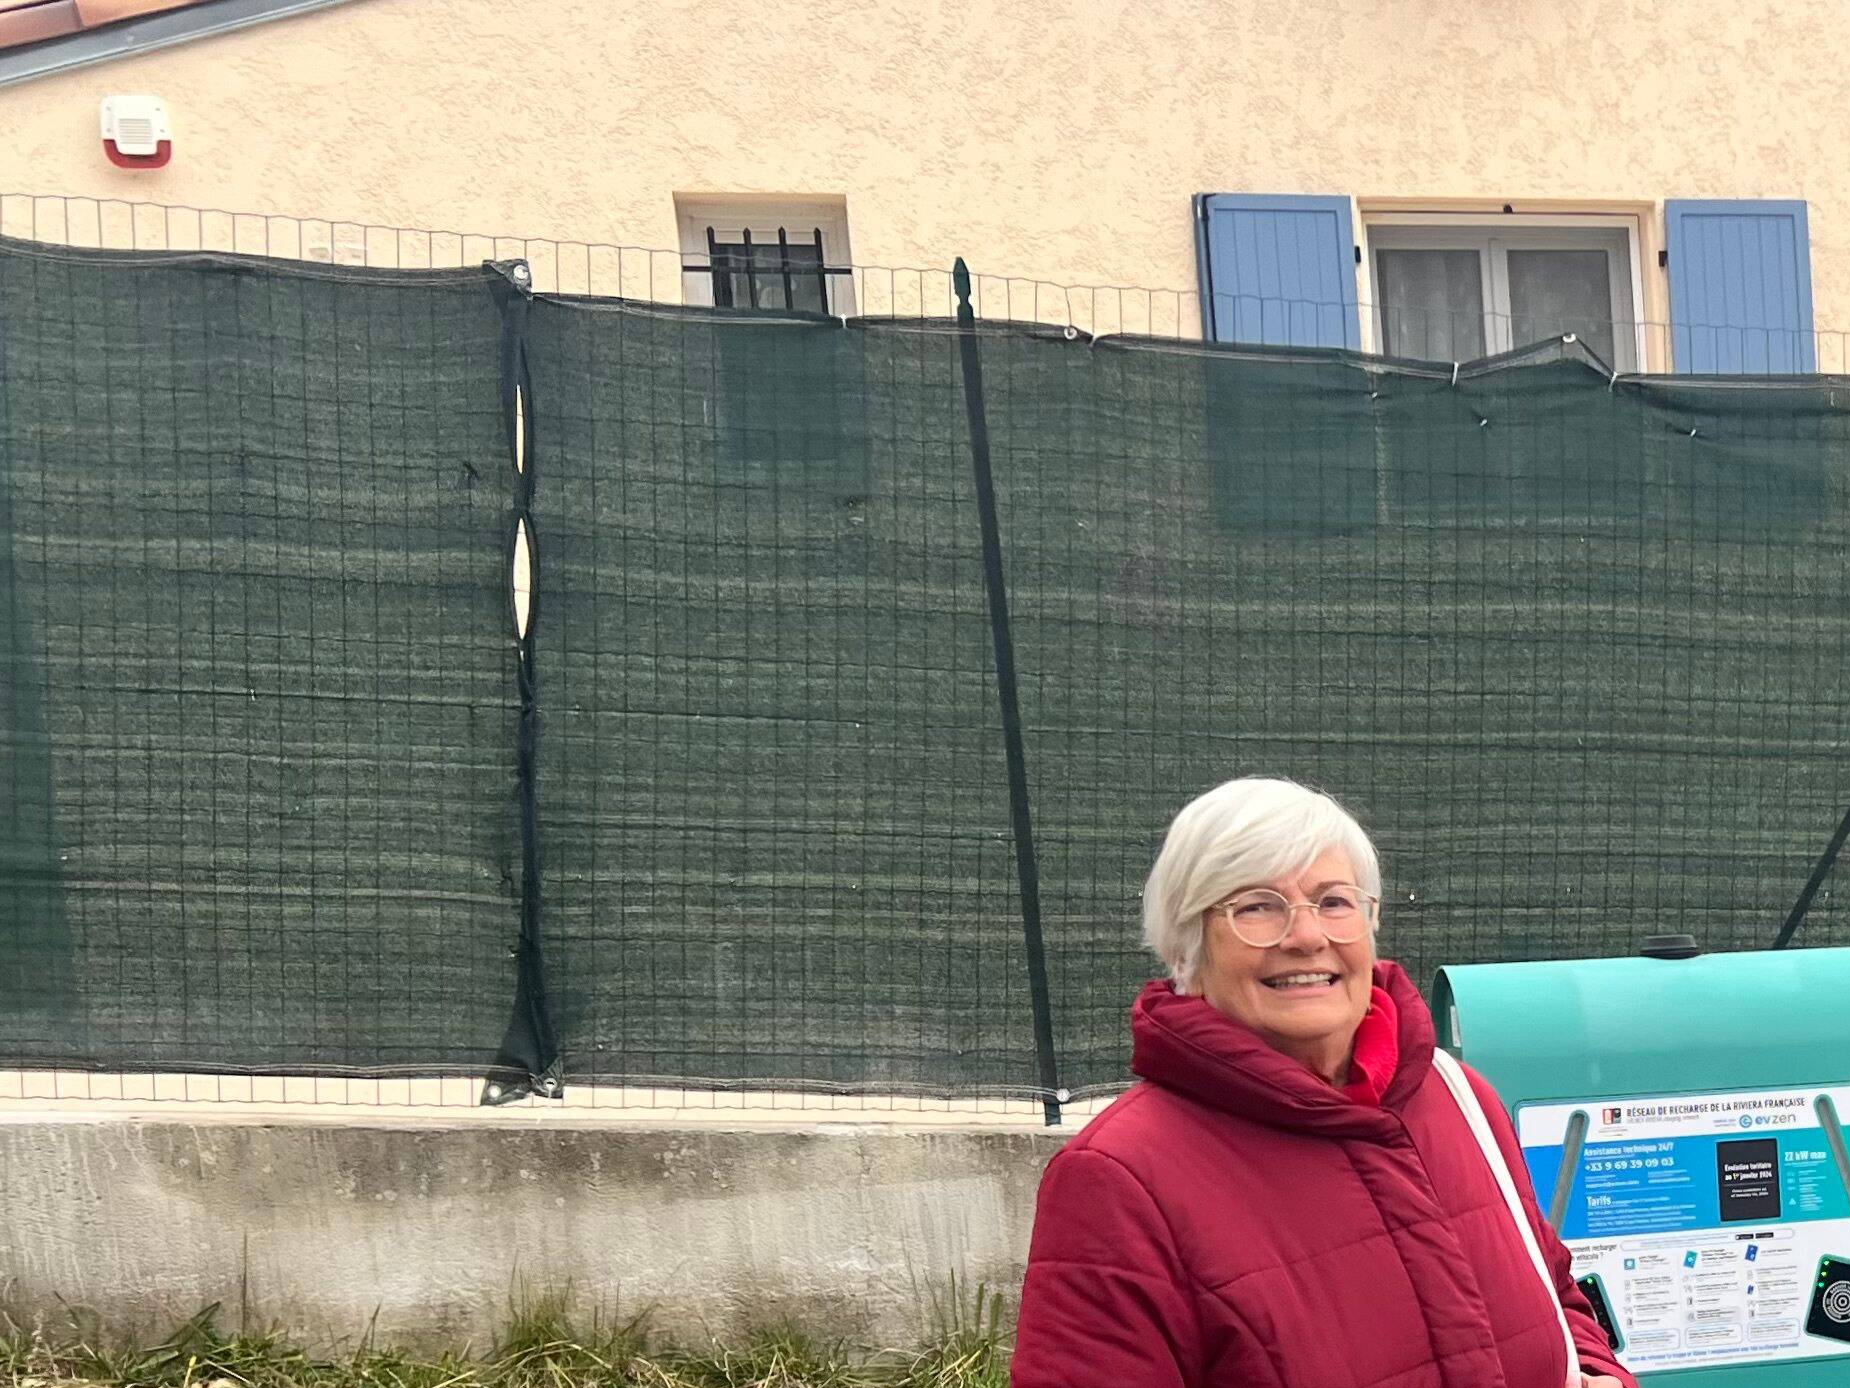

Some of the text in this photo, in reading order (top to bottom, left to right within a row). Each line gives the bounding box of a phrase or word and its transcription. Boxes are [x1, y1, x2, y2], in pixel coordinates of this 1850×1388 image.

[1627, 1097, 1806, 1118] RÉSEAU DE RECHARGE DE LA RIVIERA FRANÇAISE
[1584, 1146, 1622, 1157] Assistance
[1585, 1162, 1602, 1172] +33
[1605, 1161, 1612, 1171] 9
[1614, 1160, 1628, 1170] 69
[1629, 1159, 1643, 1169] 39
[1645, 1158, 1659, 1168] 09
[1586, 1196, 1612, 1208] Tarifs
